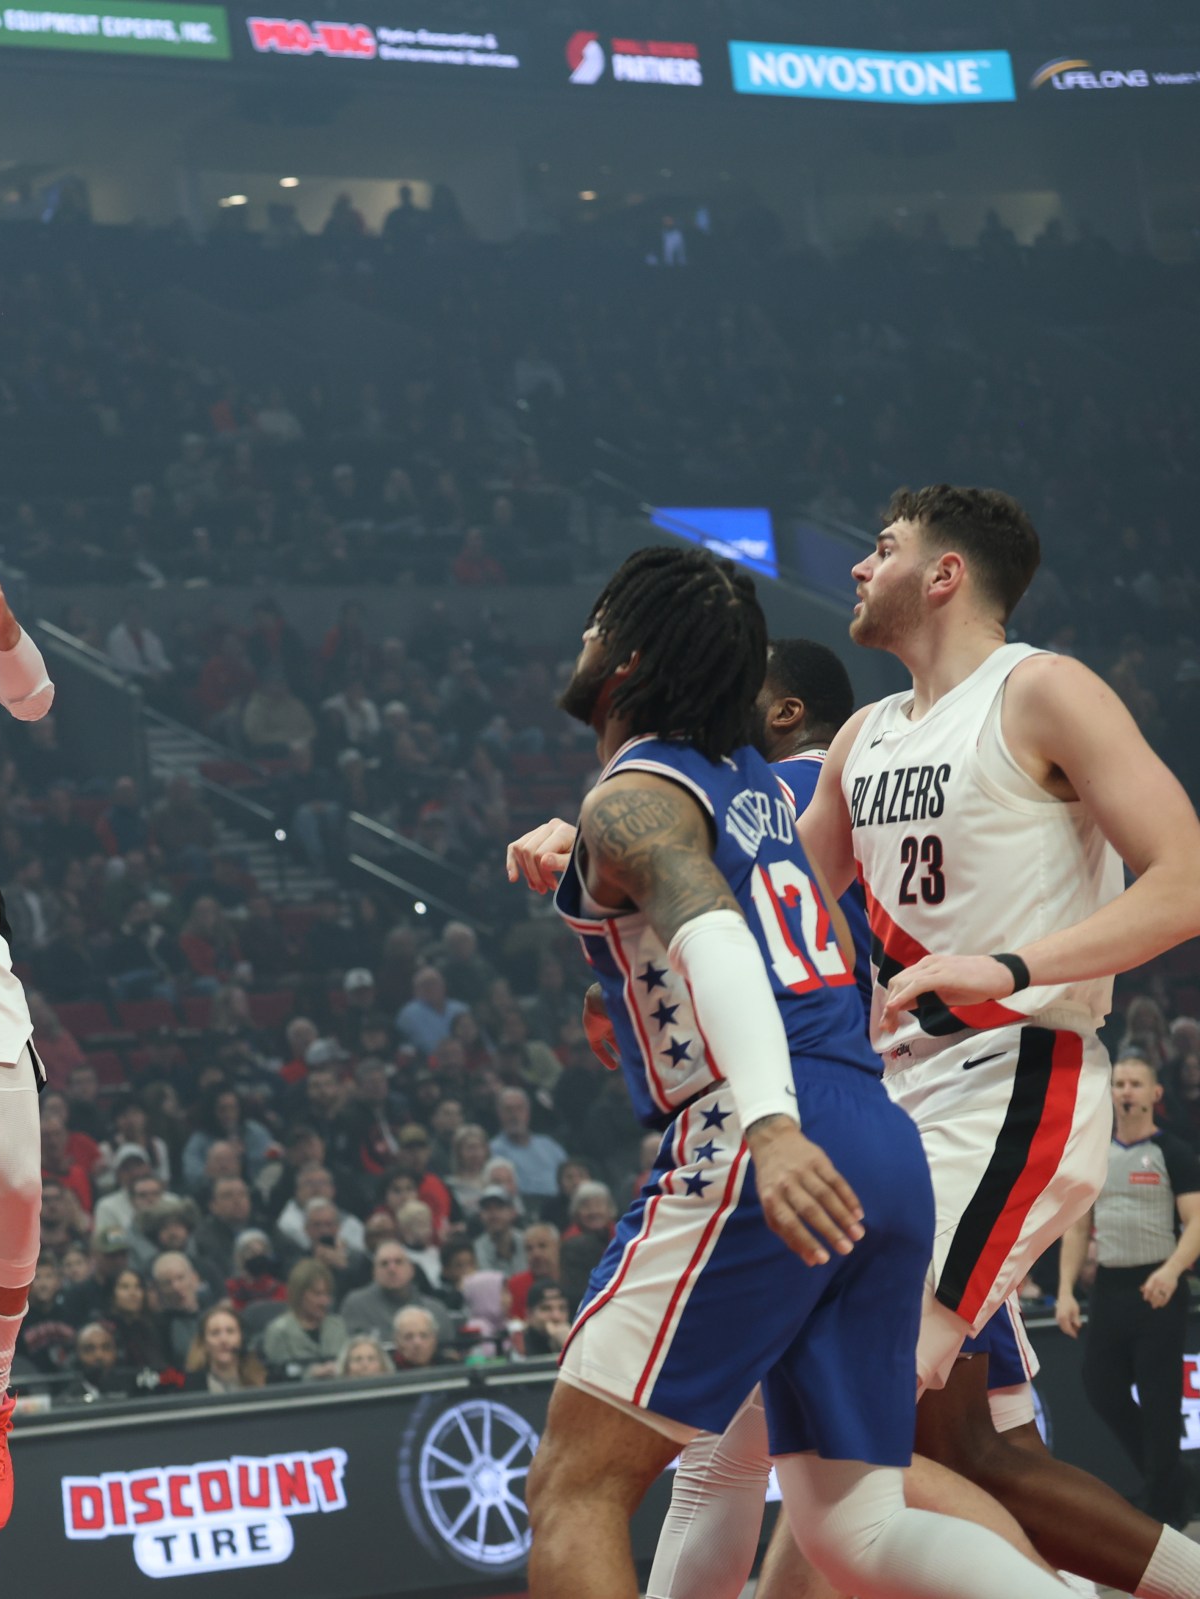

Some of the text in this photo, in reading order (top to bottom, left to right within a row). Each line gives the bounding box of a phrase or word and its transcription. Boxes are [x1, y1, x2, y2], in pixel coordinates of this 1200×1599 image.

[611, 53, 704, 87] PARTNERS
[851, 763, 952, 830] BLAZERS
[898, 834, 946, 906] 23
[751, 860, 854, 992] 12
[65, 1453, 343, 1534] DISCOUNT
[154, 1524, 271, 1563] TIRE
